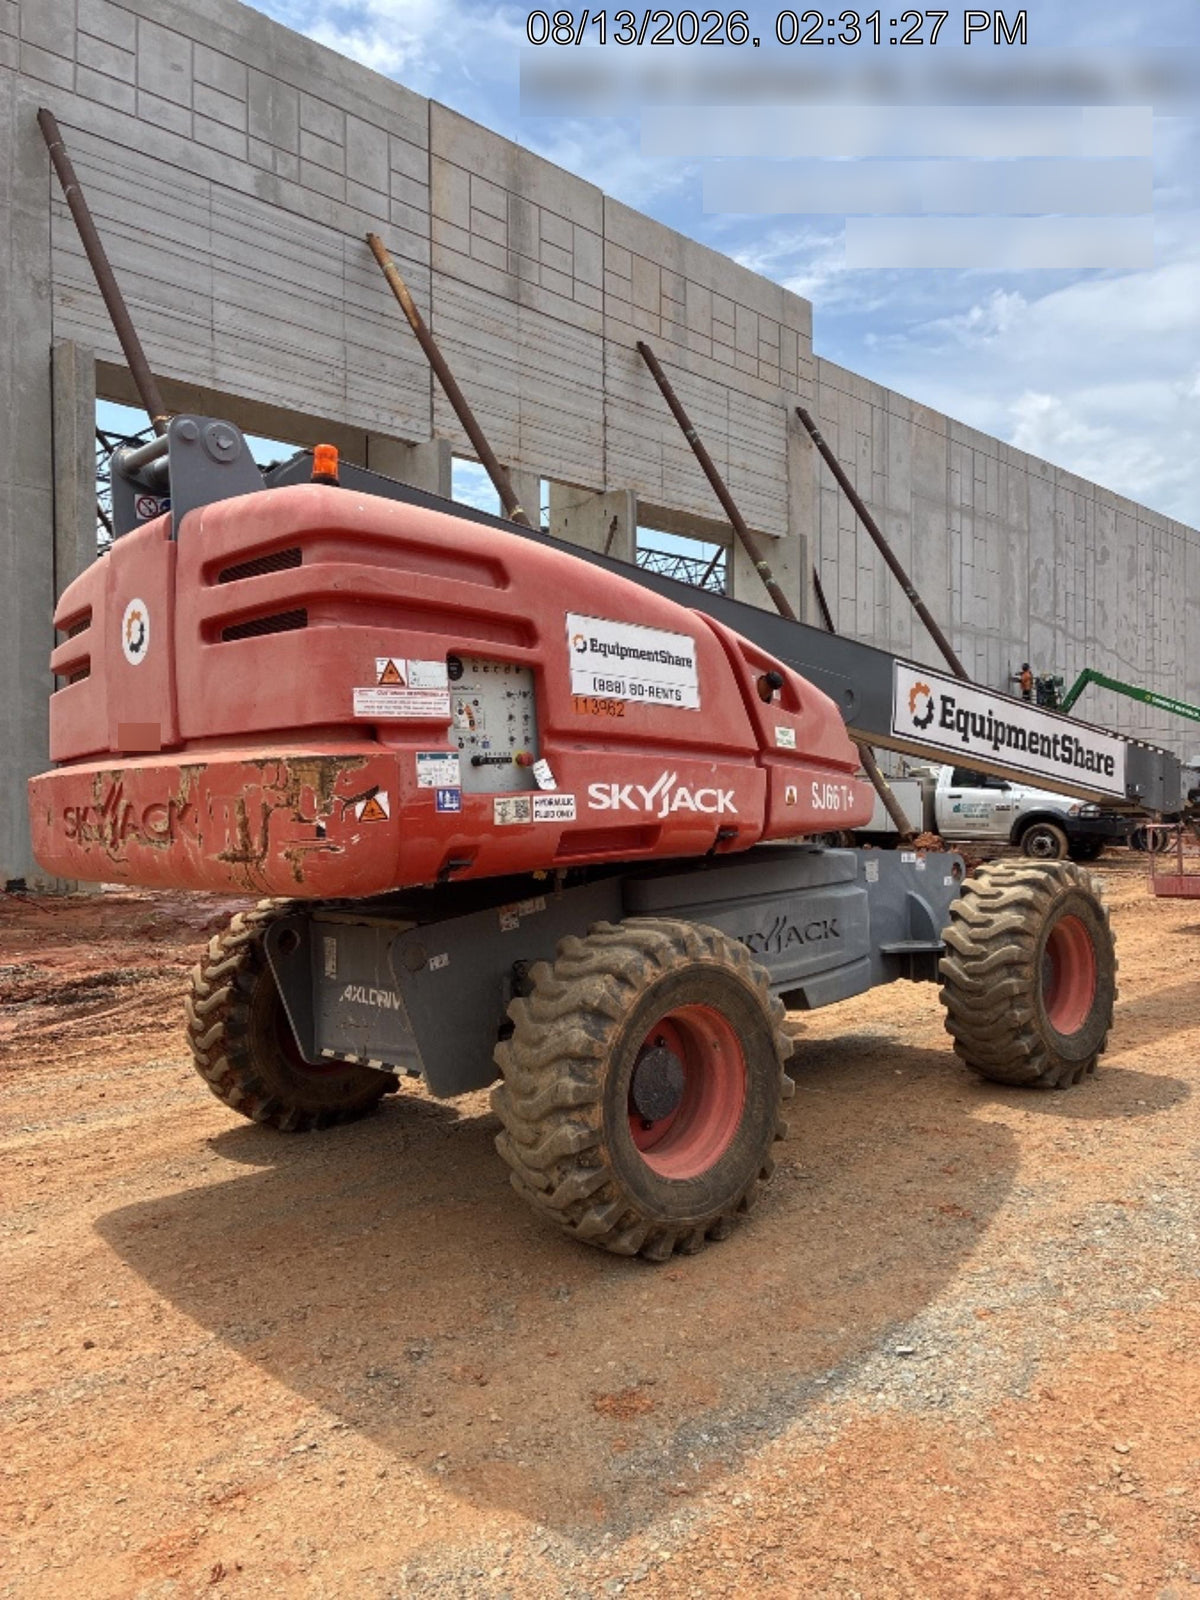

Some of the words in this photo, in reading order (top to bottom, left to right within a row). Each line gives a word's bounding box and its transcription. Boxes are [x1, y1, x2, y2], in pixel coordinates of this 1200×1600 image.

[589, 637, 693, 668] EquipmentShare
[593, 677, 626, 695] (888)
[629, 683, 682, 701] 80-RENTS
[939, 695, 1115, 776] EquipmentShare
[588, 770, 738, 818] SKYJACK
[736, 915, 840, 954] KYJACK
